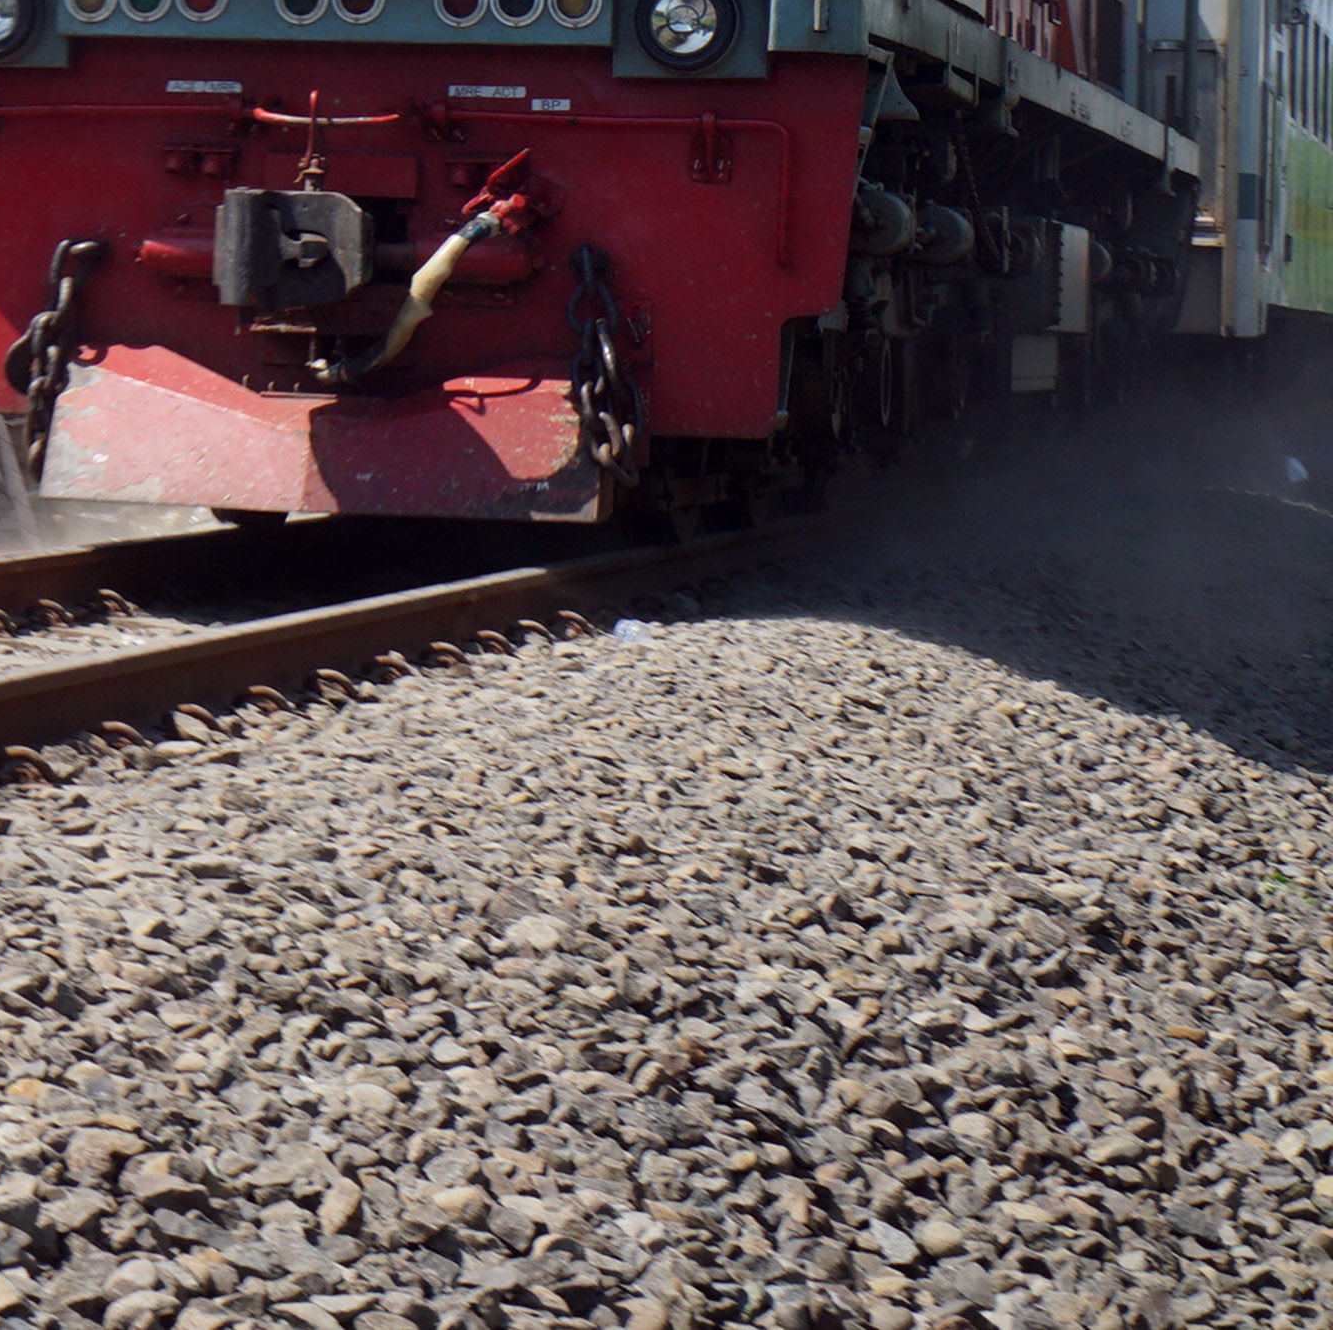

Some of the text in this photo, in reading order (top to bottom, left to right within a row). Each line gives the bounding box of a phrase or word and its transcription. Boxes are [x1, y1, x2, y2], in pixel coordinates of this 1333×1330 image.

[453, 86, 520, 98] MRE ACT
[540, 99, 562, 111] BP
